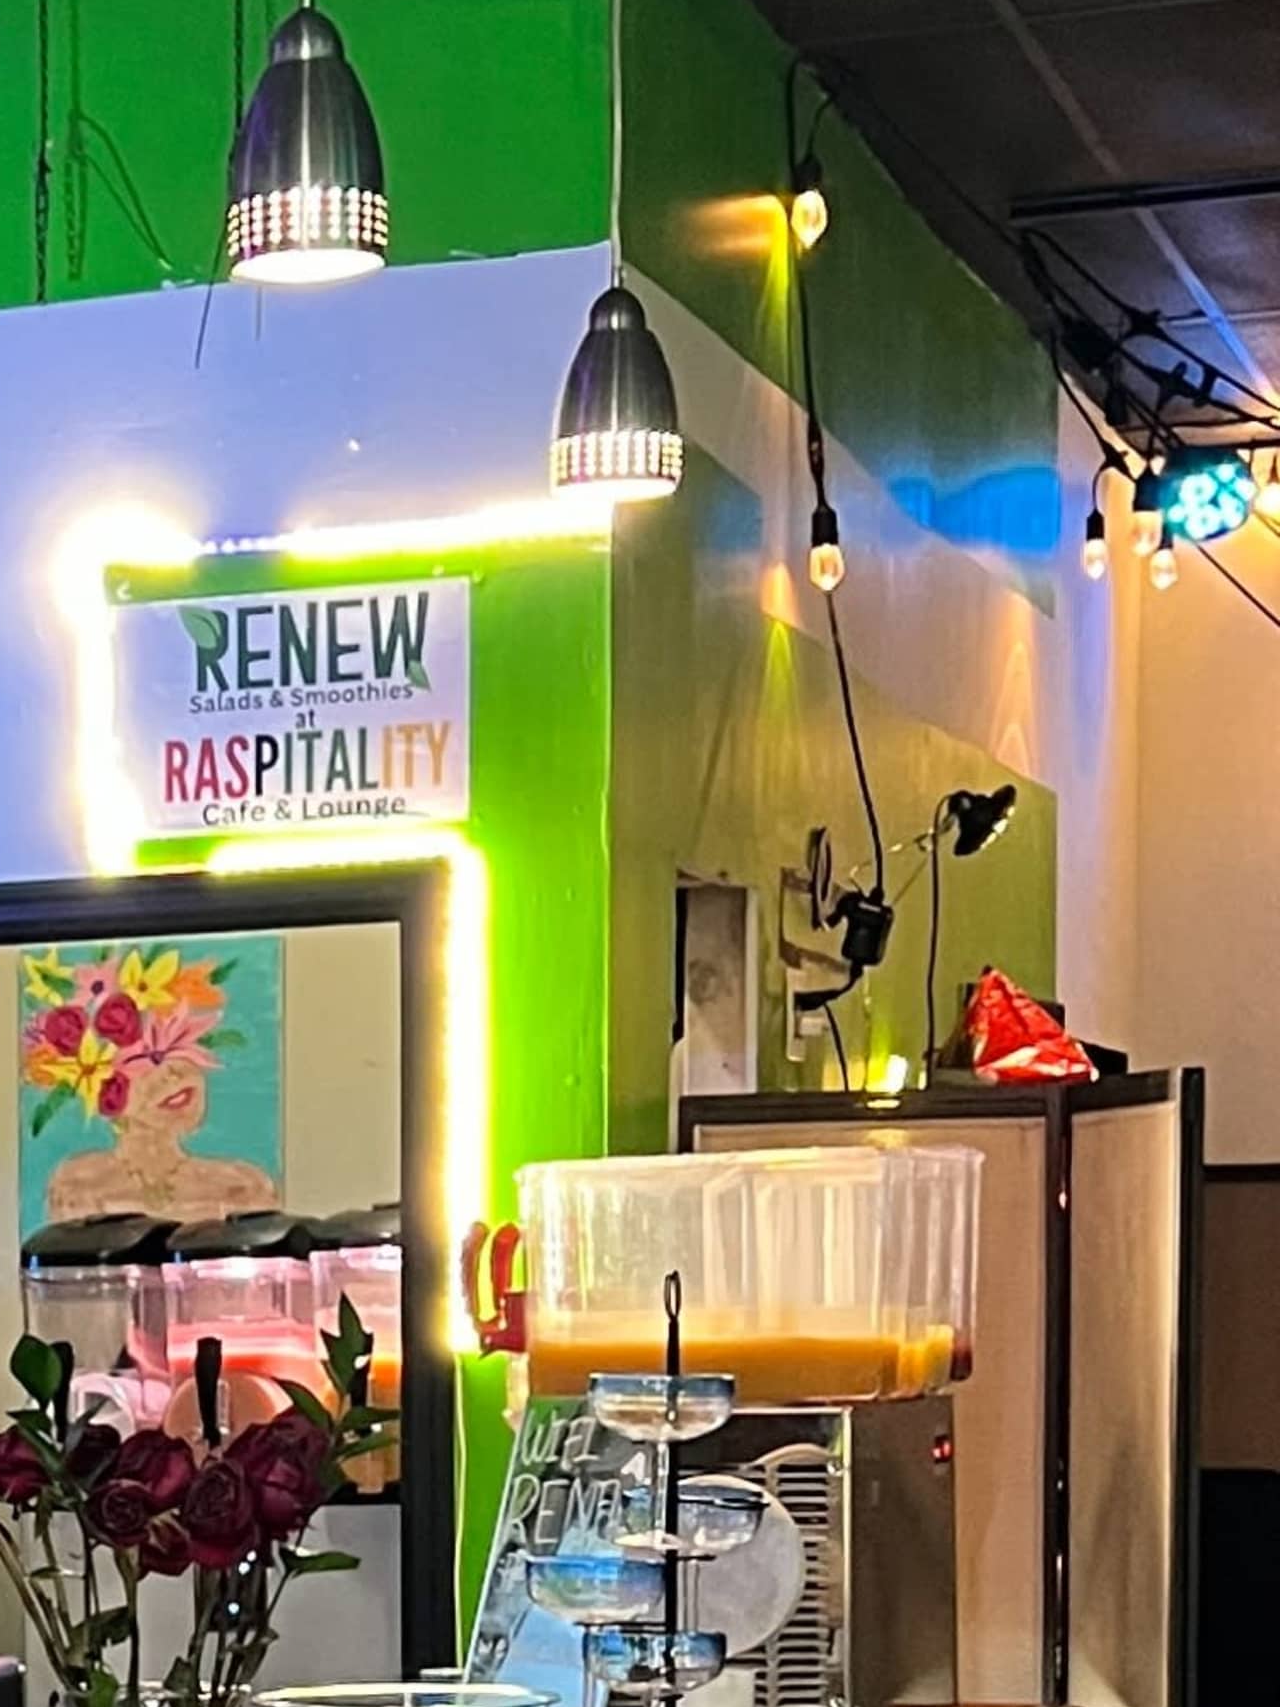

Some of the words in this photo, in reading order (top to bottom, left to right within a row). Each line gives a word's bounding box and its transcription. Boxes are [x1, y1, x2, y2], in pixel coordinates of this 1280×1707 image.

[185, 592, 430, 692] RENEW
[190, 692, 263, 714] Salads
[269, 690, 286, 707] &
[290, 682, 414, 707] Smoothies
[295, 710, 316, 728] at
[164, 721, 452, 805] RASPITALITY
[202, 799, 266, 827] Cafe
[273, 798, 292, 820] &
[301, 796, 406, 821] Lounge
